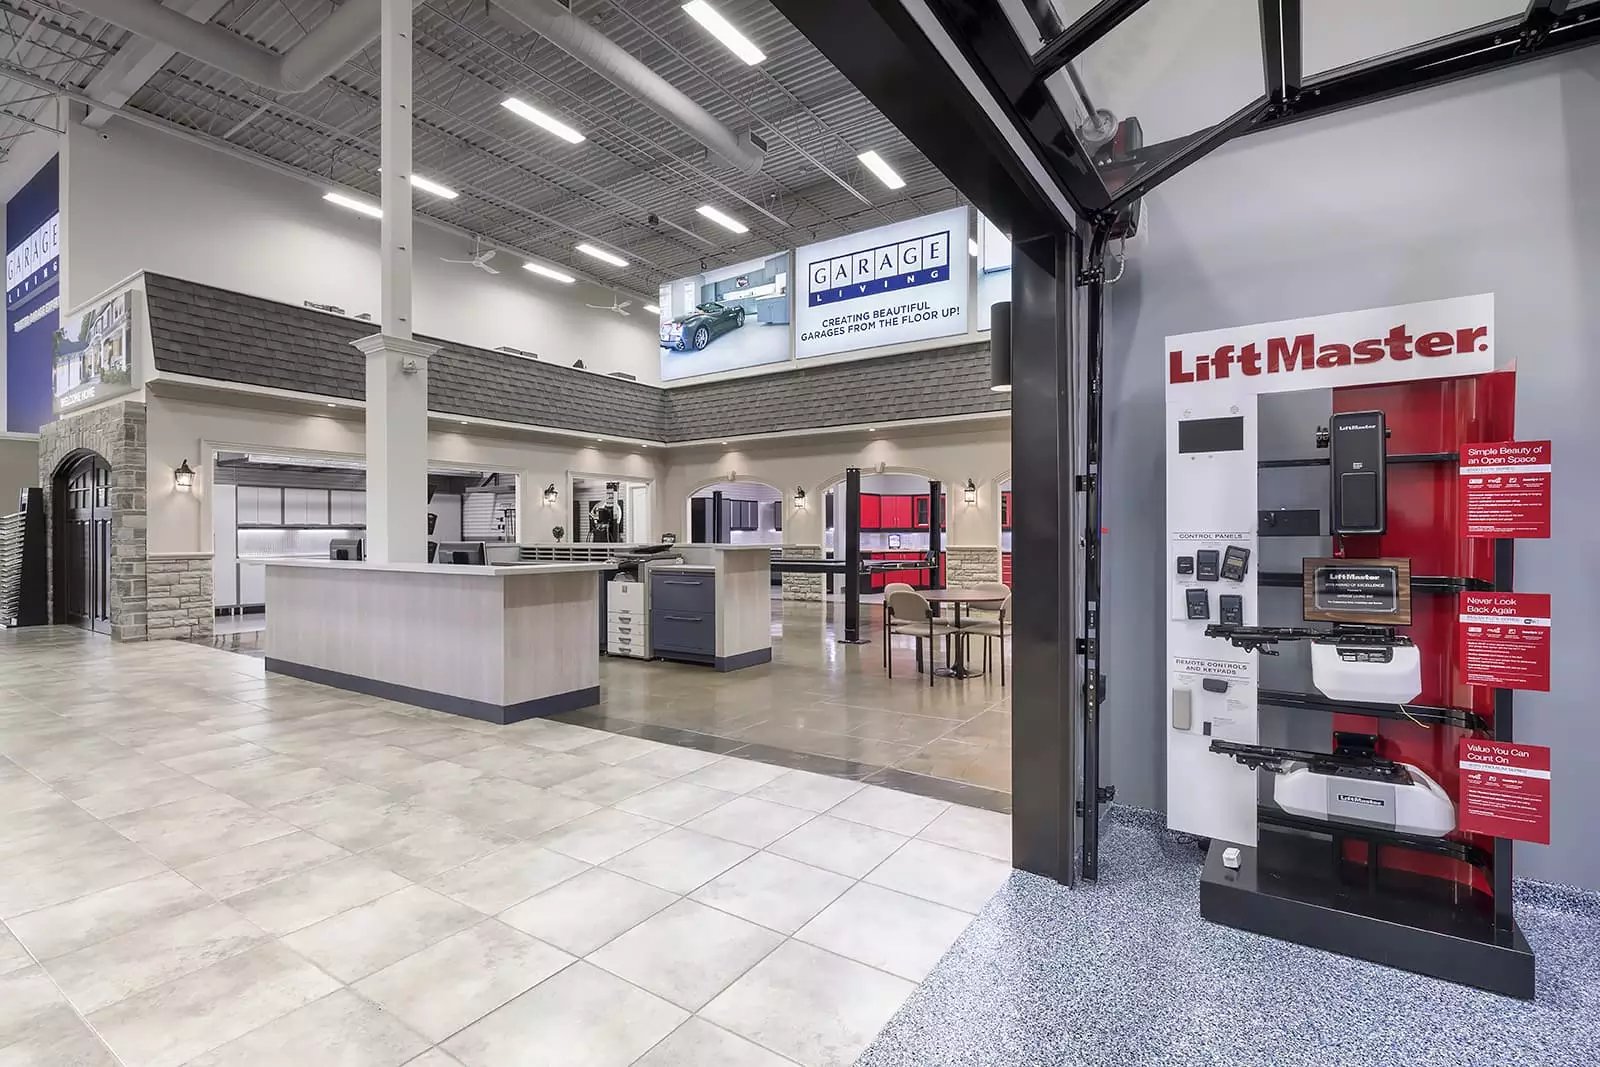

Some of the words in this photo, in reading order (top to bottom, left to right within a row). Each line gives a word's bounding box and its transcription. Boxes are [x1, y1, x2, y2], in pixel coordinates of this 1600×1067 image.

[8, 223, 57, 280] GARAGE
[814, 242, 939, 284] GARAGE
[816, 270, 939, 302] LIVING
[822, 311, 870, 328] CREATING
[873, 301, 930, 318] BEAUTIFUL
[801, 327, 845, 342] GARAGES
[847, 321, 876, 334] FROM
[879, 319, 898, 329] THE
[902, 311, 938, 325] FLOOR
[941, 306, 960, 318] UP!
[1468, 447, 1498, 457] Simple
[1500, 446, 1531, 455] Beauty
[1481, 456, 1506, 465] Open
[1507, 455, 1537, 465] Space
[1329, 573, 1380, 581] LiftMaster
[1467, 597, 1493, 605] Never
[1494, 598, 1517, 606] Look
[1491, 607, 1517, 616] Again
[1202, 667, 1237, 675] KEYPADS
[1207, 662, 1247, 670] CONTROLS
[1466, 743, 1490, 753] Value
[1492, 747, 1509, 755] You
[1510, 749, 1530, 758] Can
[1467, 752, 1494, 762] Count
[1495, 756, 1509, 764] On
